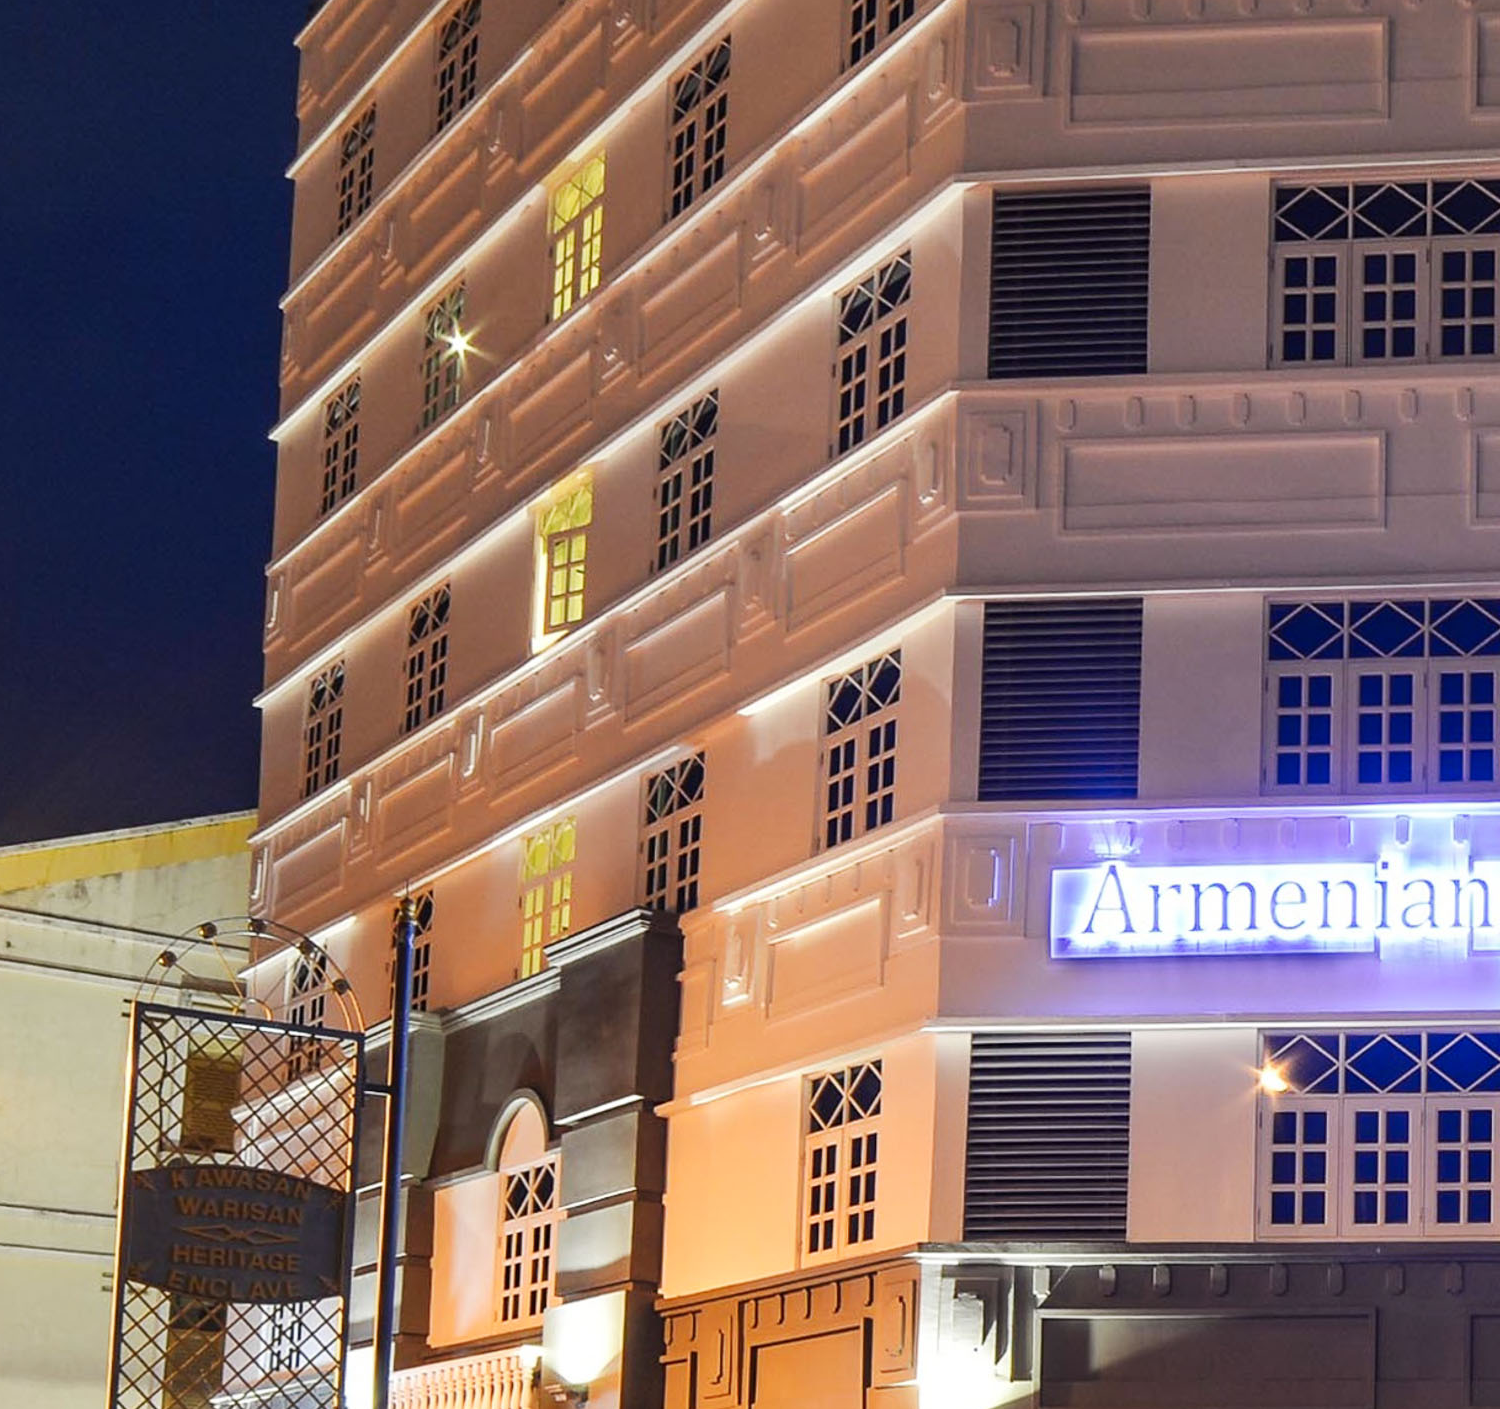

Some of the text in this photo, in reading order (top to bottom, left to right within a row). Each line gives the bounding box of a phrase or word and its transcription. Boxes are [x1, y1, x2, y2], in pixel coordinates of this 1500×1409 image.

[1082, 860, 1492, 934] Armenian
[171, 1168, 313, 1201] KAWASAN
[176, 1196, 305, 1224] WARISAN
[172, 1244, 300, 1272] HERITAGE
[167, 1270, 301, 1299] ENCLAVE
